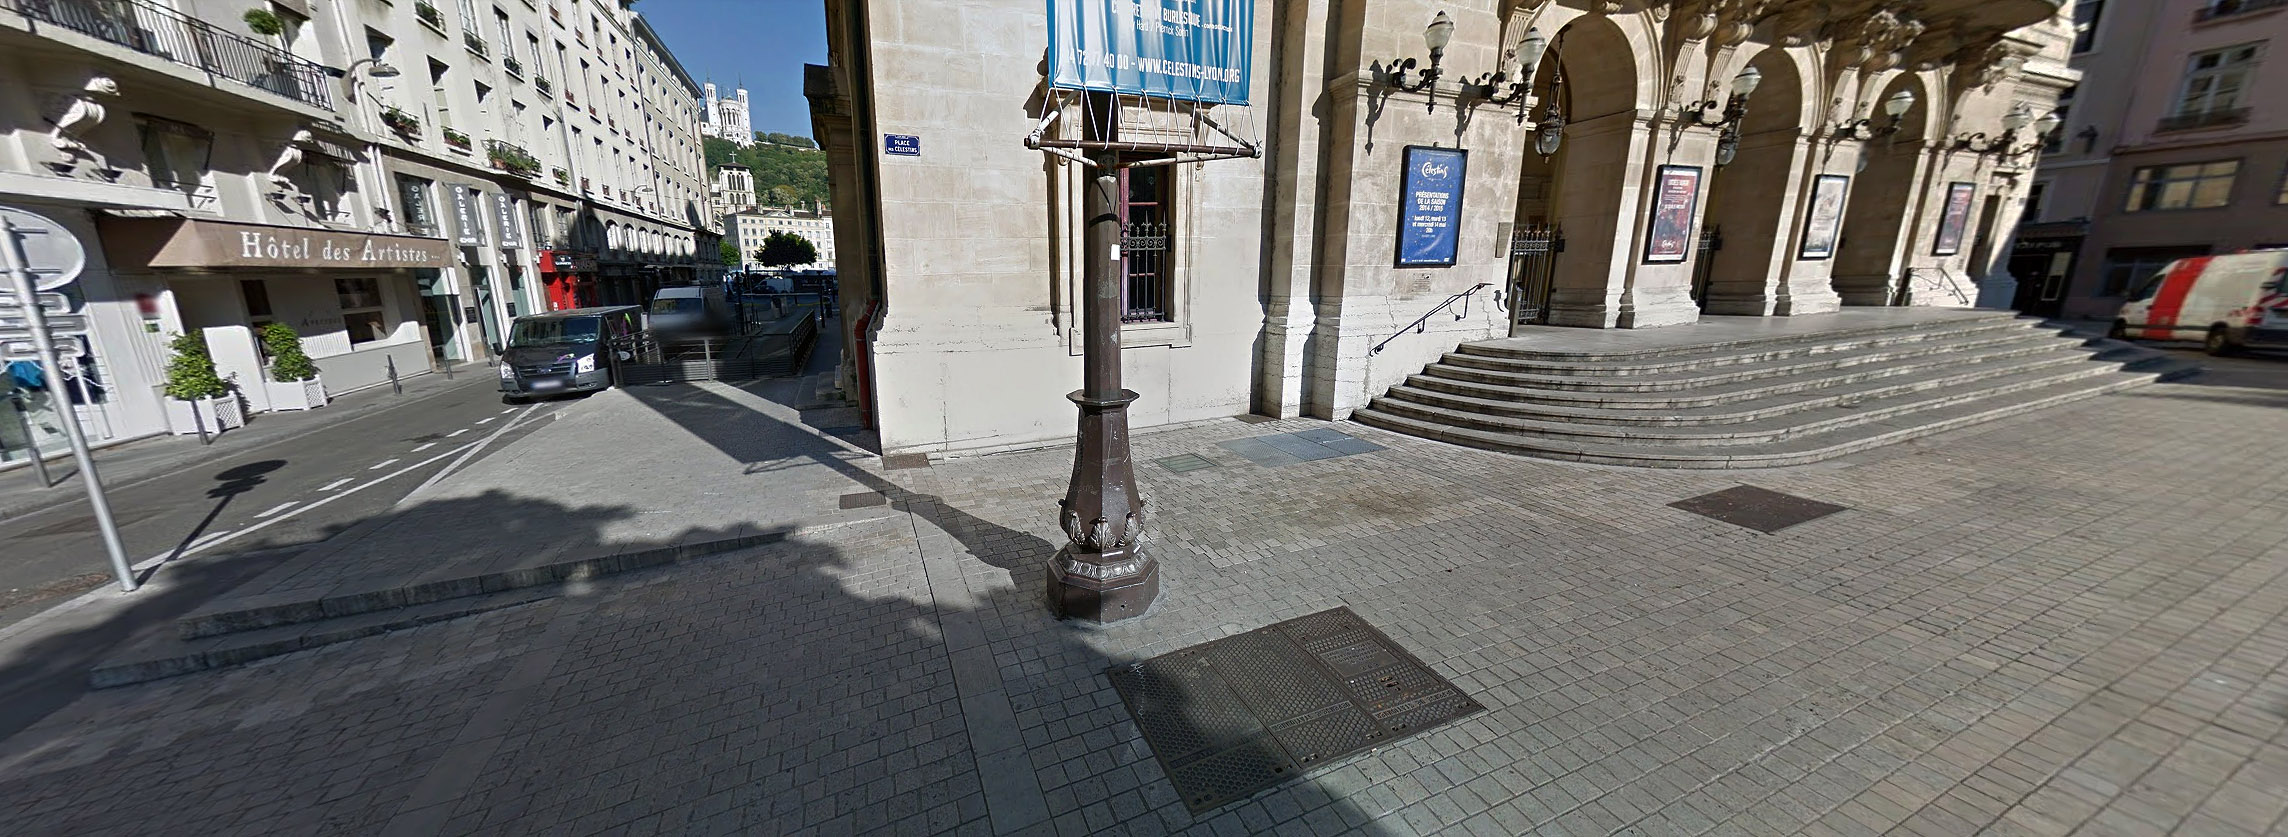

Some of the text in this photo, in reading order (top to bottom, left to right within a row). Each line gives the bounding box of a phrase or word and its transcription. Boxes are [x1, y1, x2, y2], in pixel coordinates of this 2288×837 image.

[1103, 52, 1115, 68] 40
[1117, 54, 1129, 70] 00
[1137, 56, 1240, 83] WWW.CELESTINS-LYON.ORG
[240, 231, 427, 262] Hôtel des Artistes
